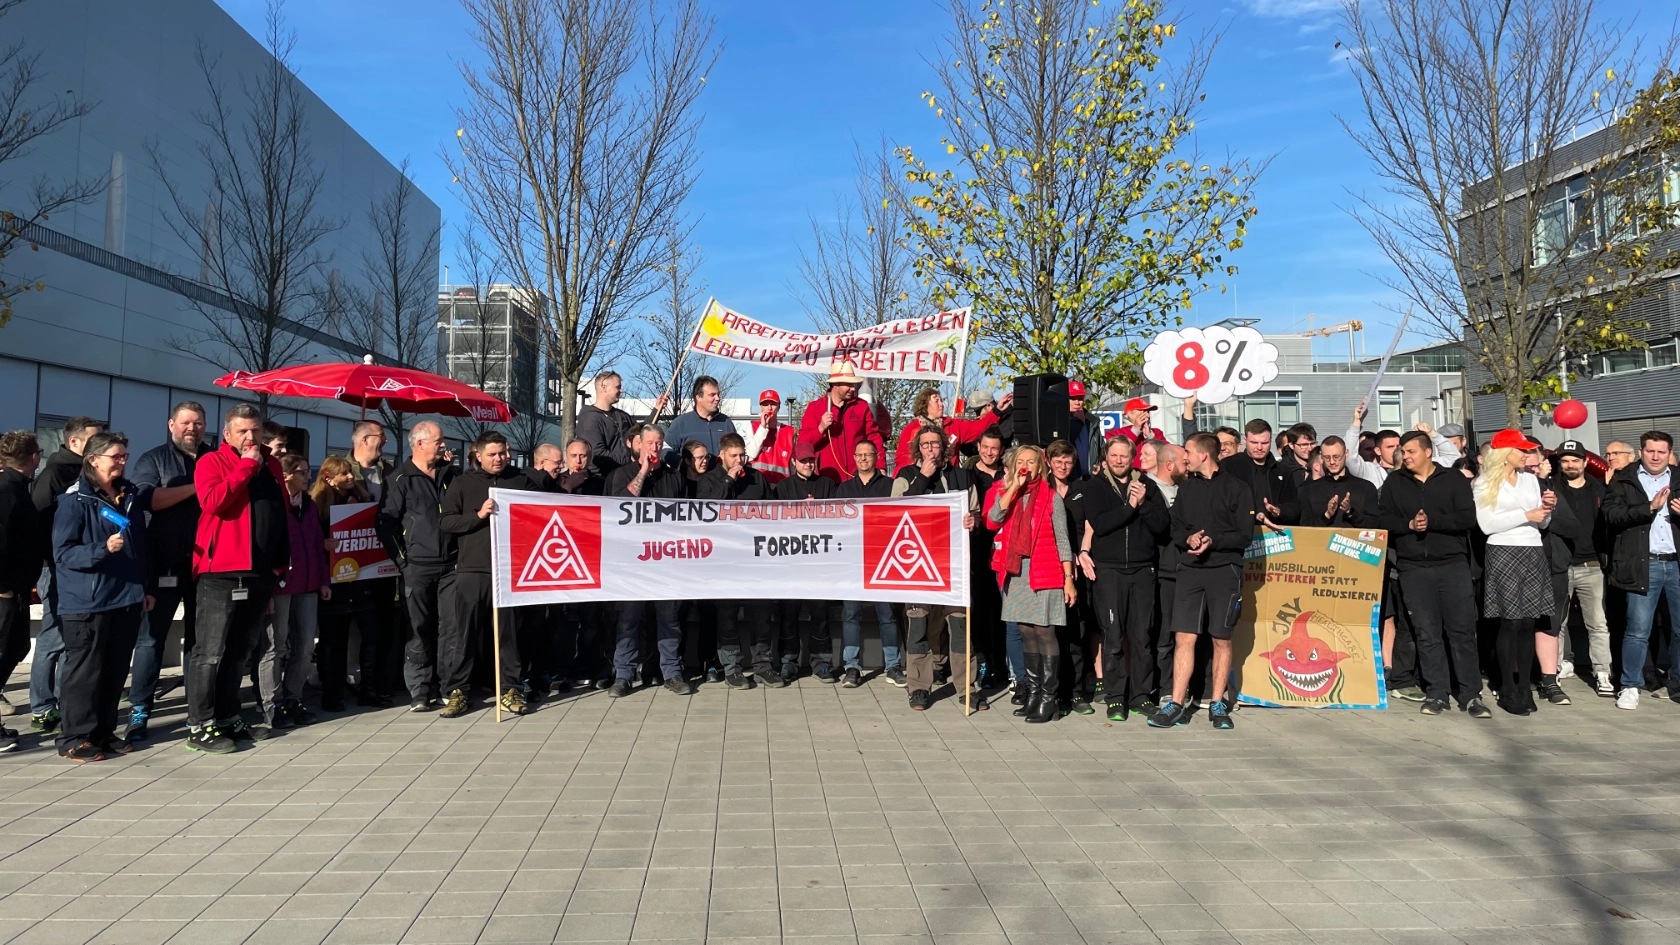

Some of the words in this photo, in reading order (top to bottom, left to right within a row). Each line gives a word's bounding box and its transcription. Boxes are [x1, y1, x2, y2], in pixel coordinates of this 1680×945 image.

[721, 311, 819, 342] ARBEITEN
[892, 310, 967, 335] LEBEN
[691, 331, 758, 361] LEBEN
[760, 349, 786, 364] UM
[831, 348, 948, 374] ARBEITEN
[784, 342, 821, 354] UND
[835, 336, 891, 349] NICHT
[472, 405, 499, 420] Meall
[1099, 415, 1116, 437] P
[333, 530, 349, 540] WIR
[334, 536, 384, 553] VERDIE
[637, 537, 713, 562] JUGEND
[1269, 543, 1294, 554] allen.
[1329, 542, 1346, 553] MIT
[1332, 533, 1367, 552] ZUKUNFT
[1365, 544, 1382, 557] NUR
[1248, 562, 1262, 571] IN
[1267, 562, 1335, 574] AUSBILDUNG
[1244, 572, 1316, 584] NVESTIEREN
[1321, 576, 1358, 586] STATT
[1271, 597, 1303, 635] JAV
